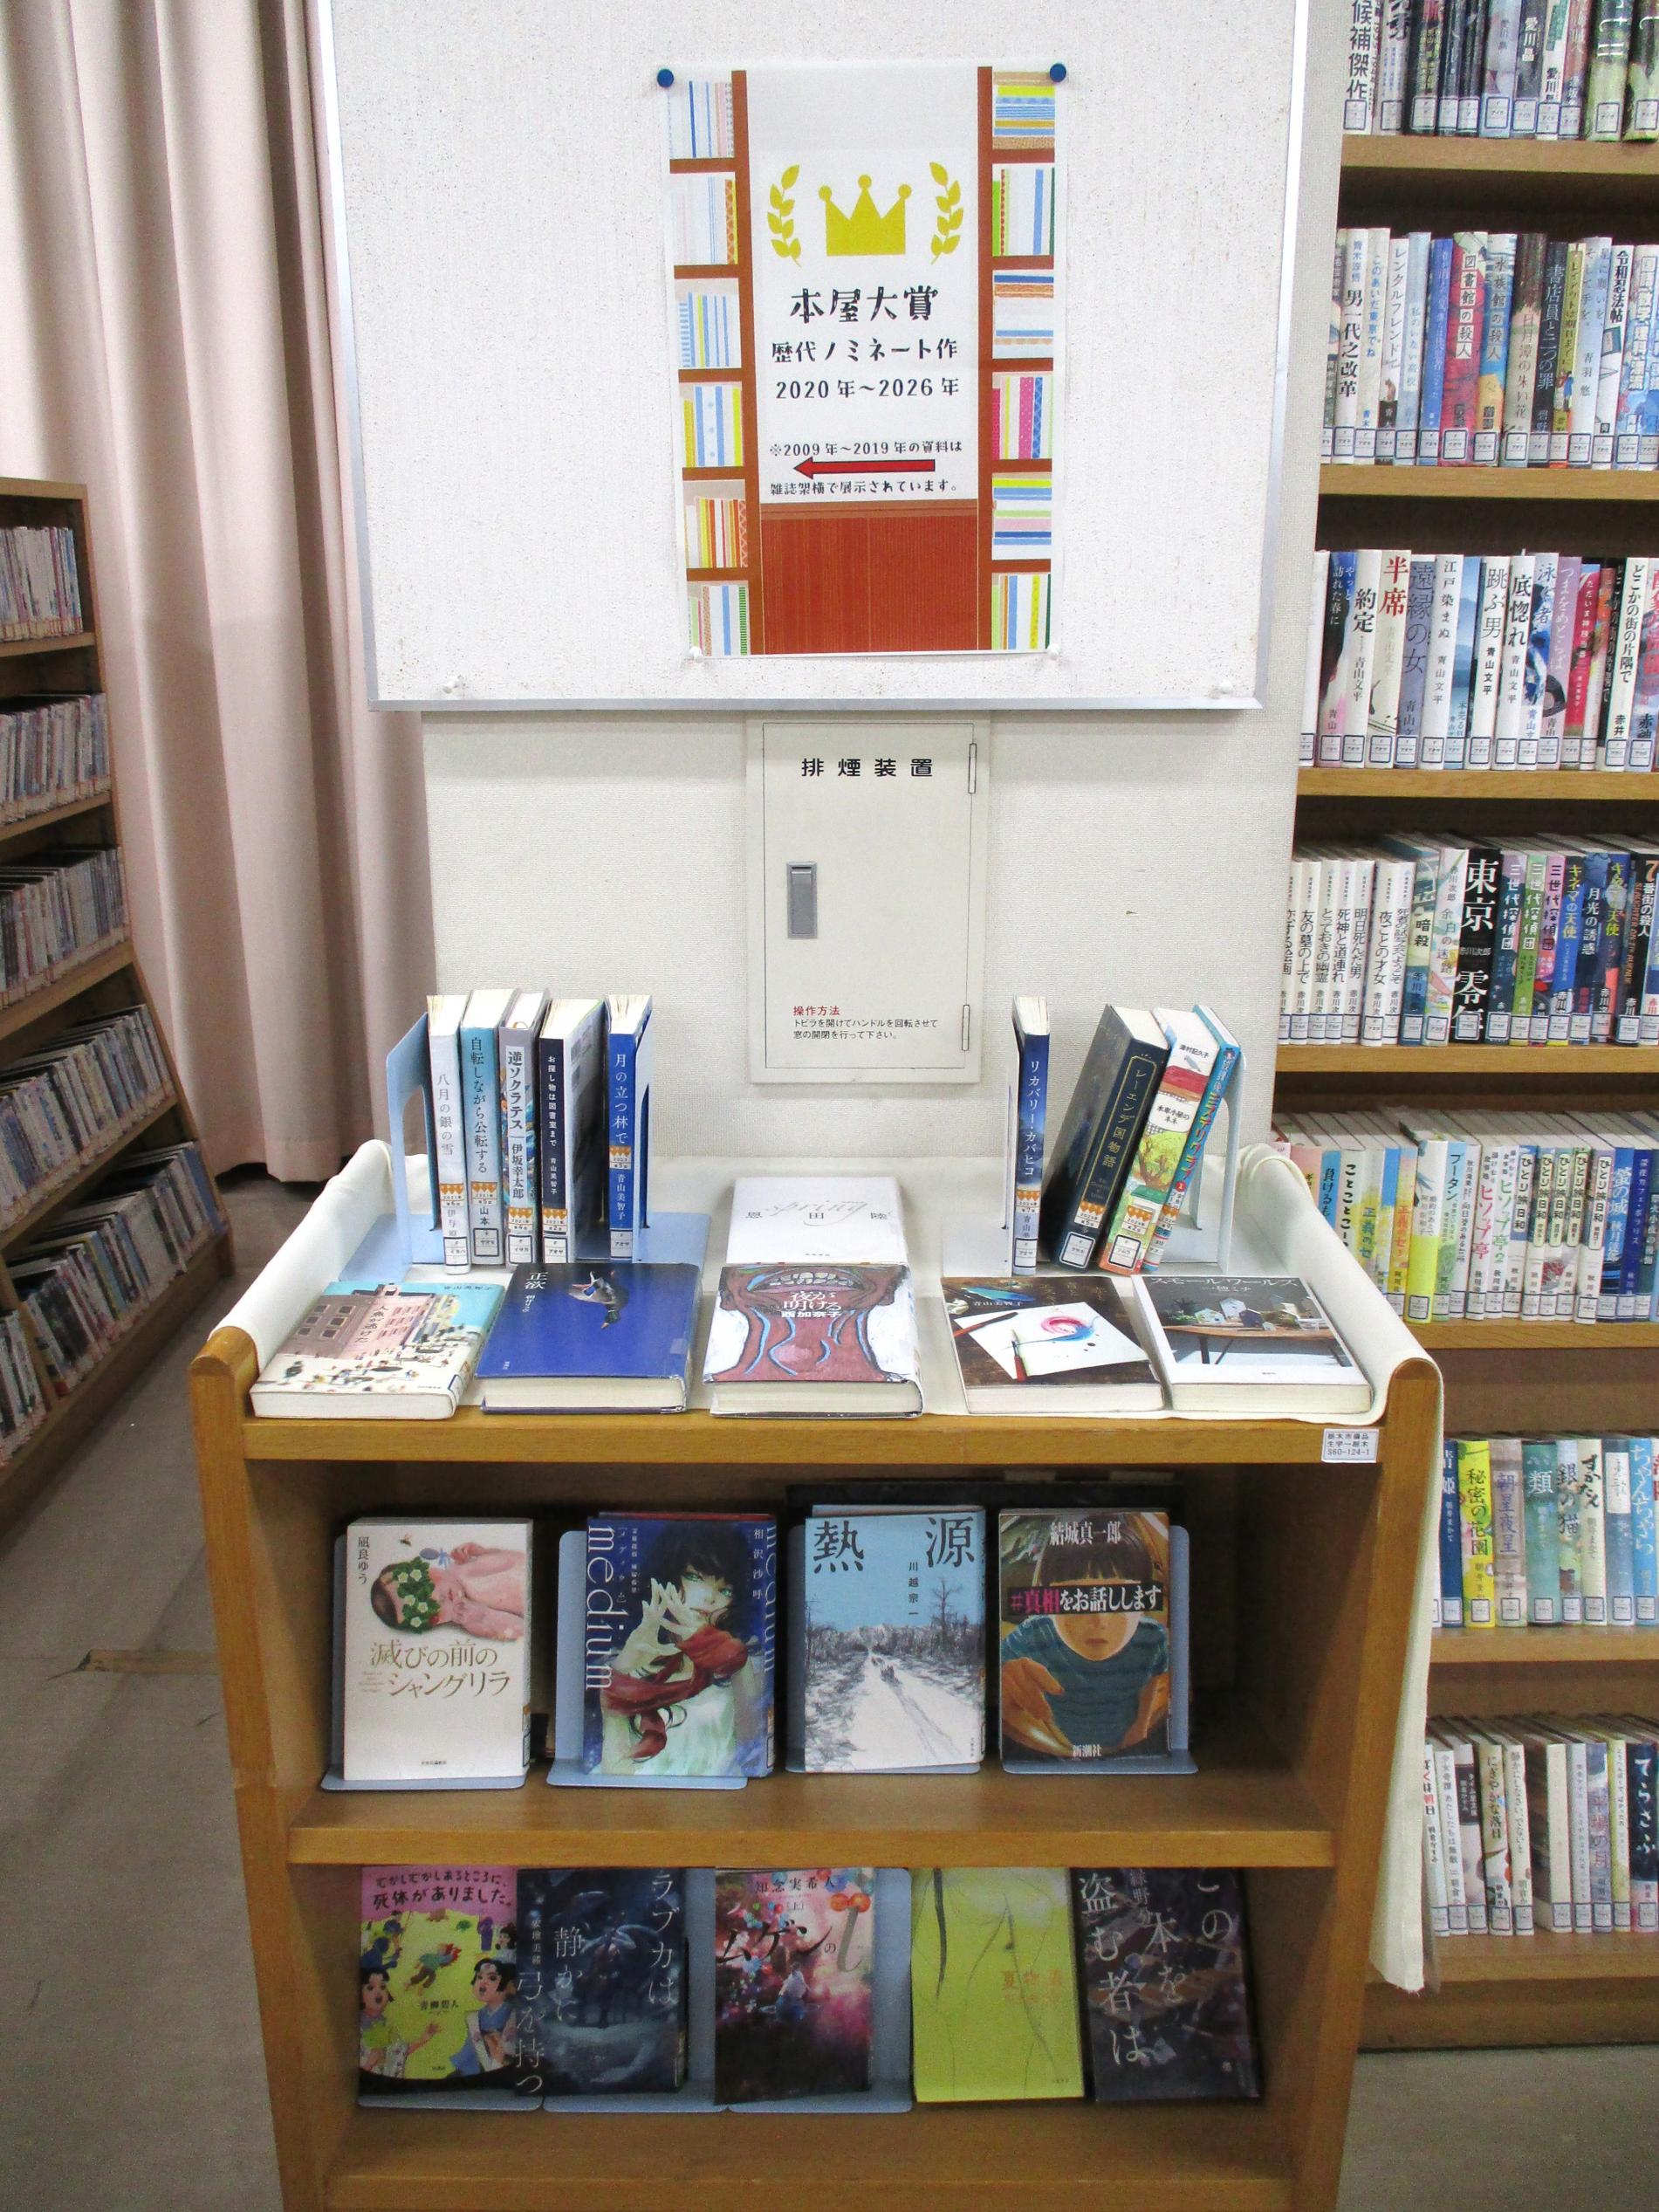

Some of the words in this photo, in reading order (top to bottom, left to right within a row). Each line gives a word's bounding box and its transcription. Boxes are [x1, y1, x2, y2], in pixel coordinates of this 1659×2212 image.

[790, 285, 938, 323] 本屋大賞
[1457, 255, 1477, 357] 図書館の殺人
[1487, 258, 1506, 361] 水族館の殺人
[1610, 250, 1628, 324] 令和忍法帖
[771, 338, 958, 363] 歴代ノミネート作
[1340, 289, 1362, 397] 男一代之改革
[1537, 264, 1565, 390] 書店員と二つの罪
[770, 478, 958, 496] 雑誌架横で展示されています。
[1329, 566, 1344, 625] 訪れた春に
[1353, 587, 1377, 633] 約定
[1379, 555, 1409, 617] 半席
[1404, 563, 1434, 675] 遠縁の女
[1437, 560, 1457, 639] 江戸染まぬ
[1483, 568, 1508, 639] 跳ぶ男
[1508, 574, 1532, 648] 底惚れ
[1619, 564, 1645, 684] どこかの街の片隅で
[1354, 656, 1367, 702] 青山文平
[1433, 655, 1447, 704] 青山文平
[1483, 646, 1497, 696] 青山文平
[1507, 655, 1519, 704] 青山文平
[802, 758, 933, 777] 排煙装置
[1460, 858, 1499, 932] 東京
[1500, 864, 1523, 950] 三世代探偵団
[1522, 864, 1544, 950] 三世代探偵団
[1541, 864, 1562, 951] 三世代探偵団
[1562, 863, 1583, 939] キネマの天使
[1581, 887, 1601, 956] 月光の誘惑
[1297, 910, 1316, 984] 友の墓の上で
[1314, 908, 1333, 983] とっておきの幽霊
[1332, 909, 1351, 983] 死神と道連れ
[1349, 908, 1368, 979] 明日死んだ男
[1374, 910, 1394, 985] 夜ごとの才女
[1415, 919, 1431, 947] 暗殺
[1436, 909, 1457, 974] 余白の迷路
[792, 1006, 840, 1016] 操作方法
[793, 1018, 939, 1028] トビラを開けてハンドルを回転させて
[793, 1029, 899, 1040] 窓の開閉を行って下さい。
[437, 1074, 454, 1156] 八月の銀の雪
[470, 1036, 489, 1173] 自転しながら公転する
[506, 1050, 524, 1130] 逆ソクラテス
[547, 1054, 558, 1147] お探し物は図書室まで
[613, 1053, 629, 1144] 月の立つ林で
[1024, 1060, 1039, 1176] リカバリー・カバヒコ
[1102, 1068, 1147, 1167] レーエンデ国物語
[511, 1142, 524, 1199] 伊坂幸太郎
[616, 1174, 627, 1220] 青山美智子
[1513, 1154, 1533, 1231] ひとり旅日和
[1535, 1155, 1554, 1219] ひとり旅日和
[1553, 1155, 1572, 1219] ひとり旅日和
[1571, 1154, 1589, 1219] ひとり旅日和
[1594, 1158, 1612, 1222] ひとり旅日和
[480, 1206, 490, 1226] 山本
[524, 1272, 549, 1290] 正欲
[783, 1301, 842, 1311] 明ける
[790, 1290, 836, 1302] 夜が
[1151, 1277, 1299, 1287] スモールワールズ
[1465, 1468, 1488, 1556] 秘密の花園
[1496, 1473, 1517, 1554] 朝星夜星
[1528, 1470, 1553, 1494] 類
[1557, 1463, 1580, 1535] 銀の猫
[357, 1535, 371, 1585] 凪良ゆう
[752, 1528, 764, 1600] 相沢沙呼
[813, 1516, 975, 1574] 熱源
[1048, 1521, 1122, 1545] 結城真一郎
[586, 1524, 629, 1691] medium
[908, 1562, 919, 1616] 川越宗一
[370, 1638, 498, 1669] 滅びの前の
[387, 1670, 511, 1699] シャングリラ
[1072, 1743, 1103, 1757] 新潮社
[373, 1886, 512, 1910] 死体がありました。
[376, 1870, 509, 1888] むかしむかしあるところに、
[756, 1877, 835, 1894] 知念実希人
[648, 1872, 681, 2005] ラブカは
[1079, 1872, 1147, 2067] 盗む者は
[1144, 1912, 1186, 2004] 本を
[553, 1926, 586, 2022] 静かに
[516, 1970, 545, 2093] 弓を持つ
